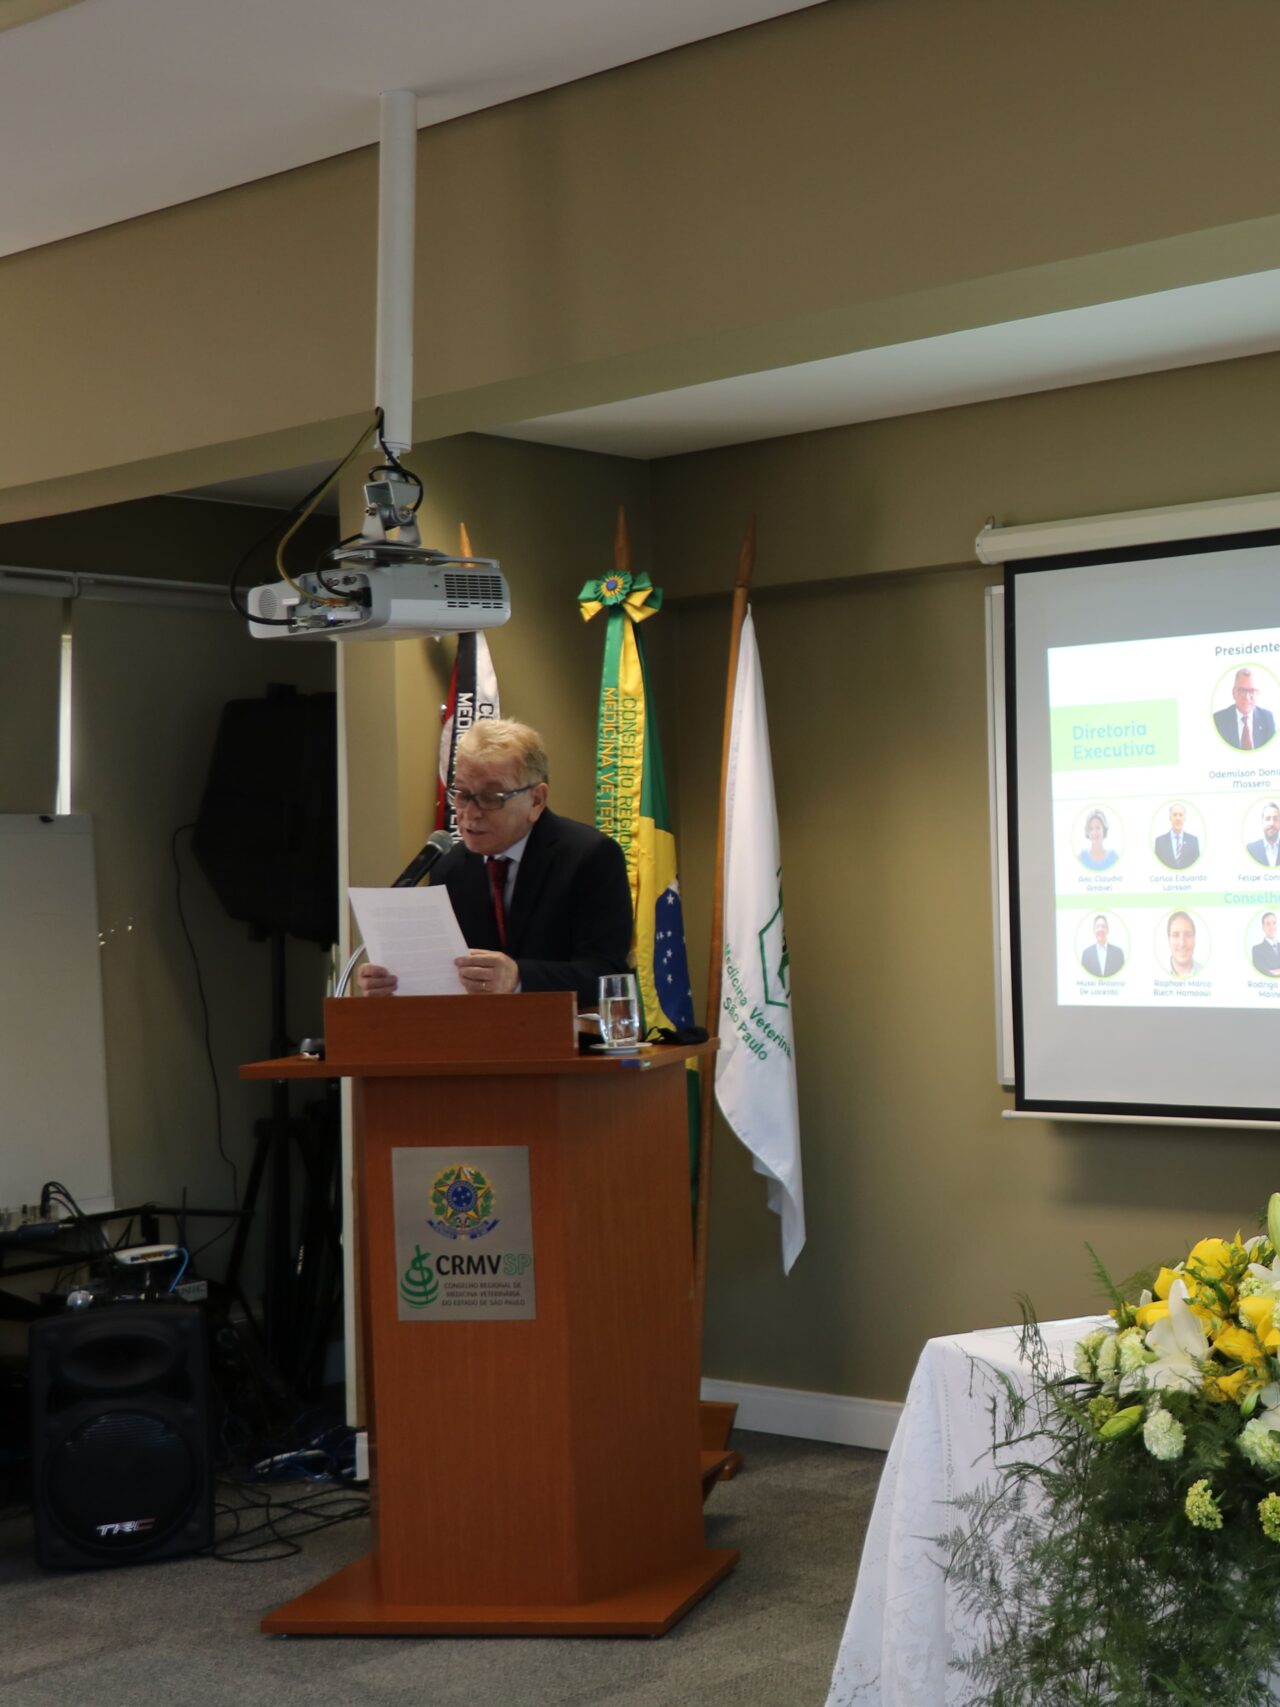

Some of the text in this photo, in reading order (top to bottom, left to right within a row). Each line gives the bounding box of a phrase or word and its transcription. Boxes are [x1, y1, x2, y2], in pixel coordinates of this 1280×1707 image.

[1215, 642, 1280, 656] Presidente
[1072, 721, 1147, 740] Diretoria
[620, 696, 637, 789] CONSELHO
[1073, 740, 1155, 760] Executiva
[599, 687, 617, 838] MEDICINA VETERI
[1208, 769, 1256, 779] Odemilson
[737, 1021, 768, 1060] Paulo
